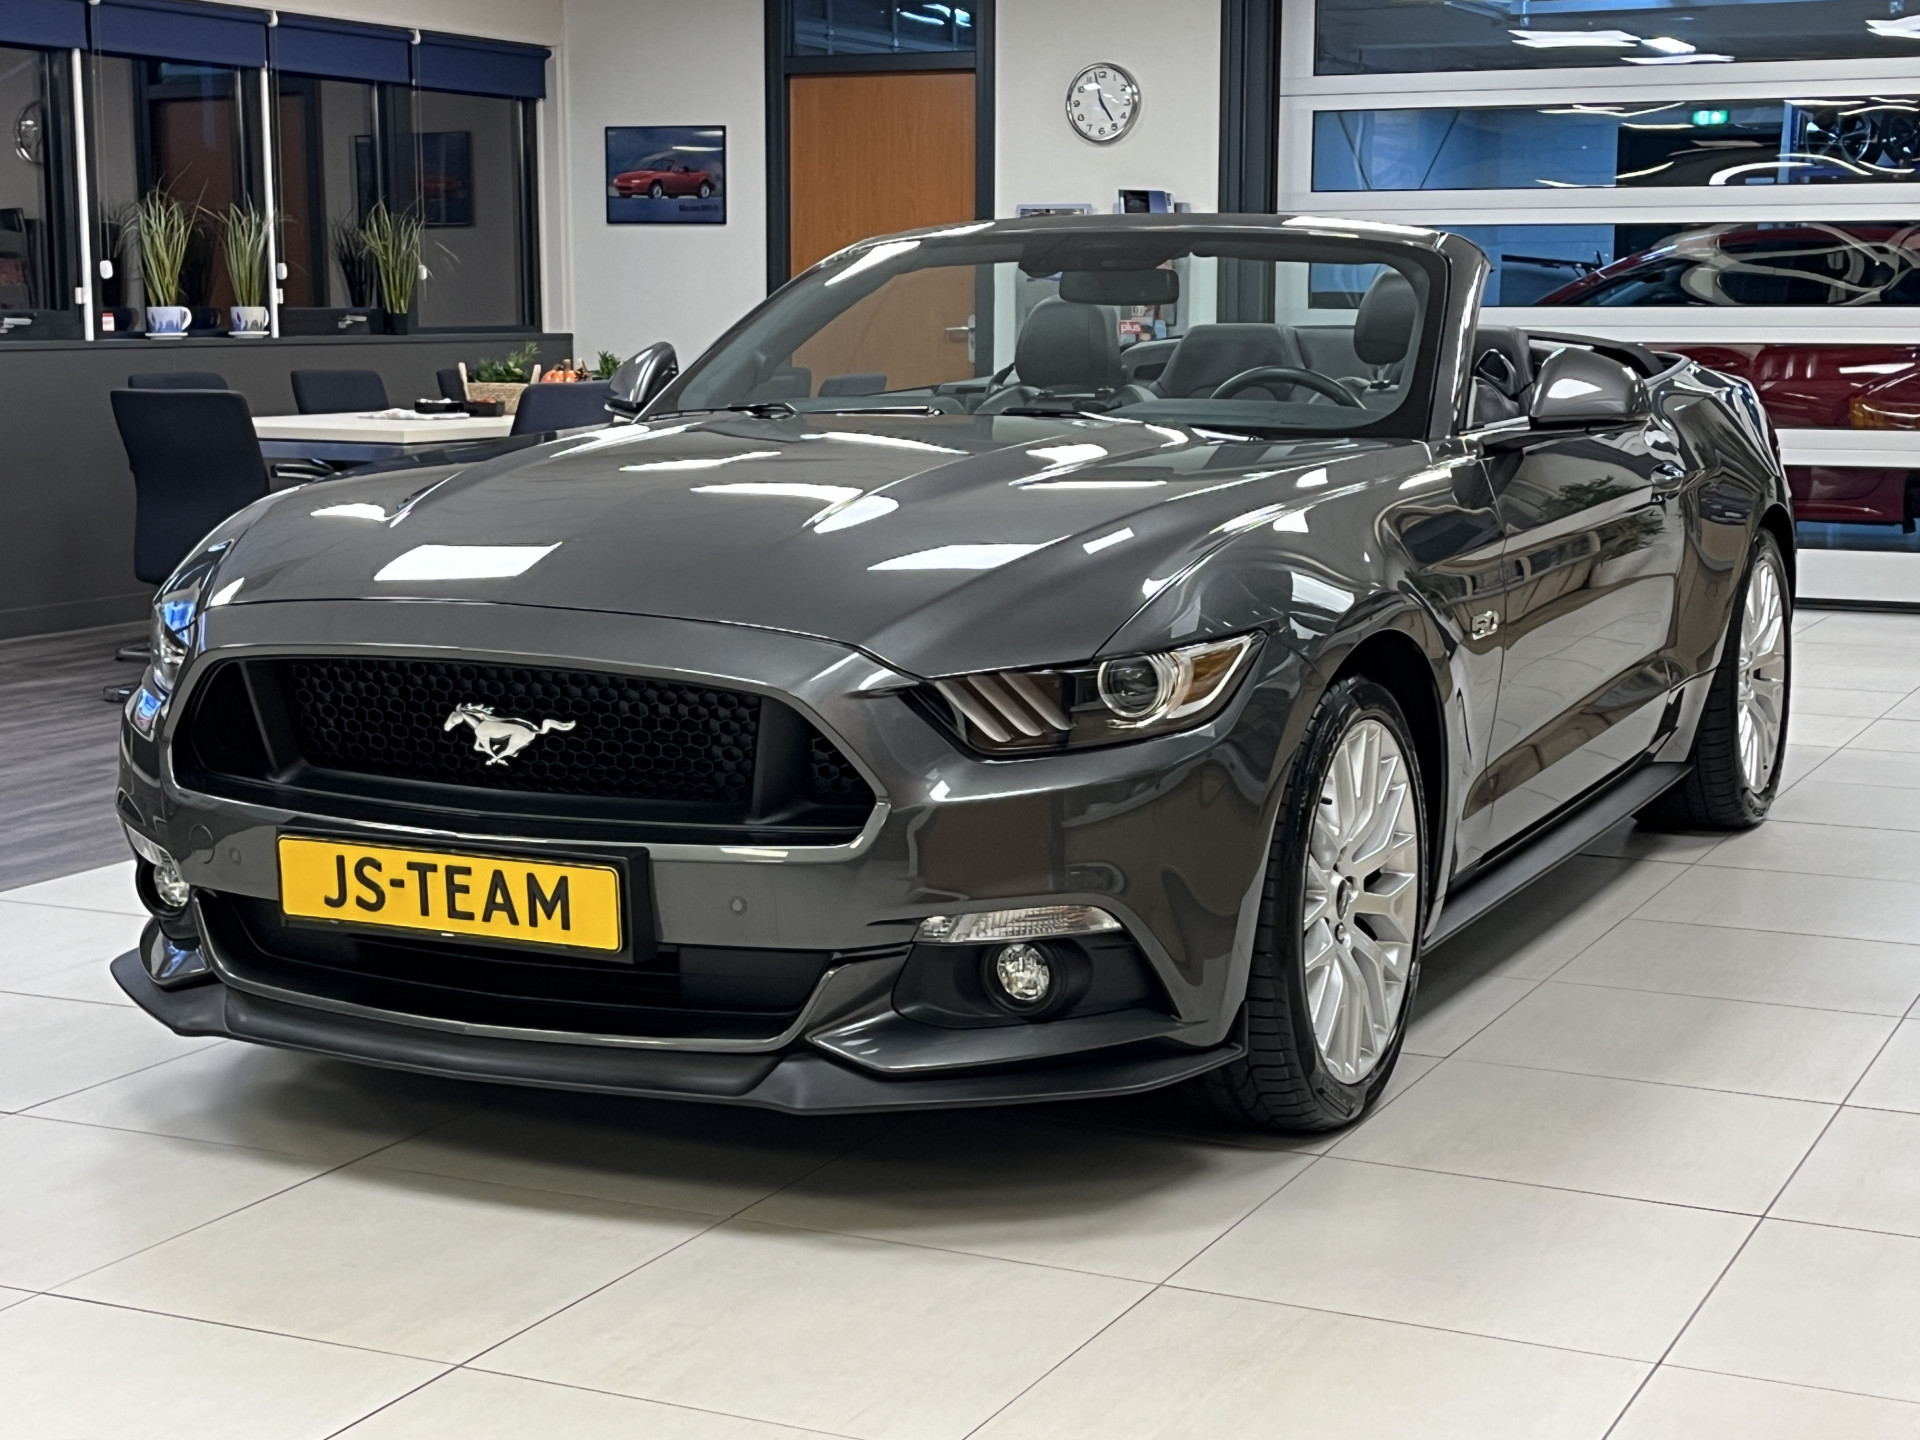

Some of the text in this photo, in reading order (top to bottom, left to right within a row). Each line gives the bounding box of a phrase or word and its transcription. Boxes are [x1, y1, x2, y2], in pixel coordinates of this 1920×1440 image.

[1120, 84, 1127, 92] 2
[1124, 98, 1131, 107] 3
[1086, 124, 1093, 132] 7
[1121, 321, 1141, 334] plus
[324, 854, 571, 931] JS-TEAM
